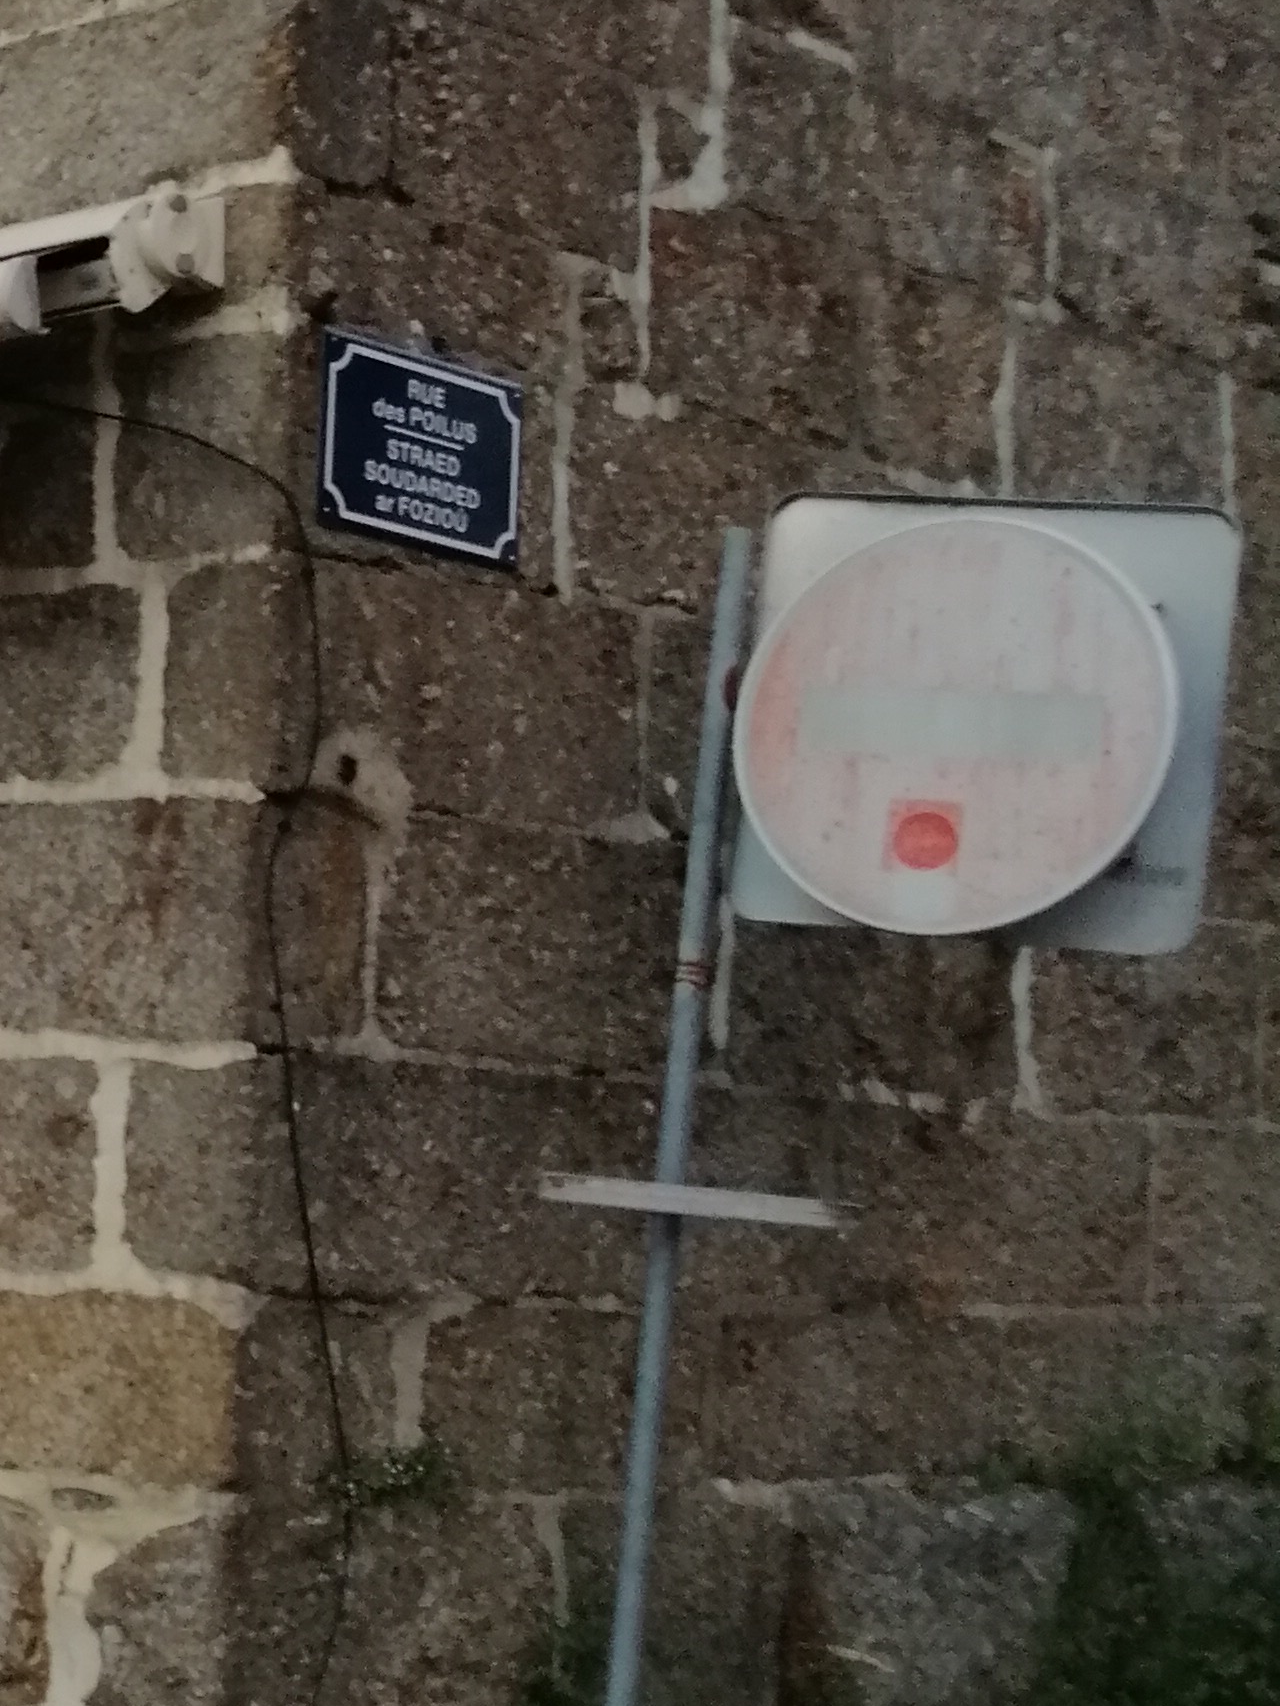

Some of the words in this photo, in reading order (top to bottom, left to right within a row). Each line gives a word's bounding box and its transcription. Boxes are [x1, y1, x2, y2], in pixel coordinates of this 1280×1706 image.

[407, 379, 447, 409] RUE
[409, 406, 478, 444] POILUS
[386, 438, 461, 477] STRAED
